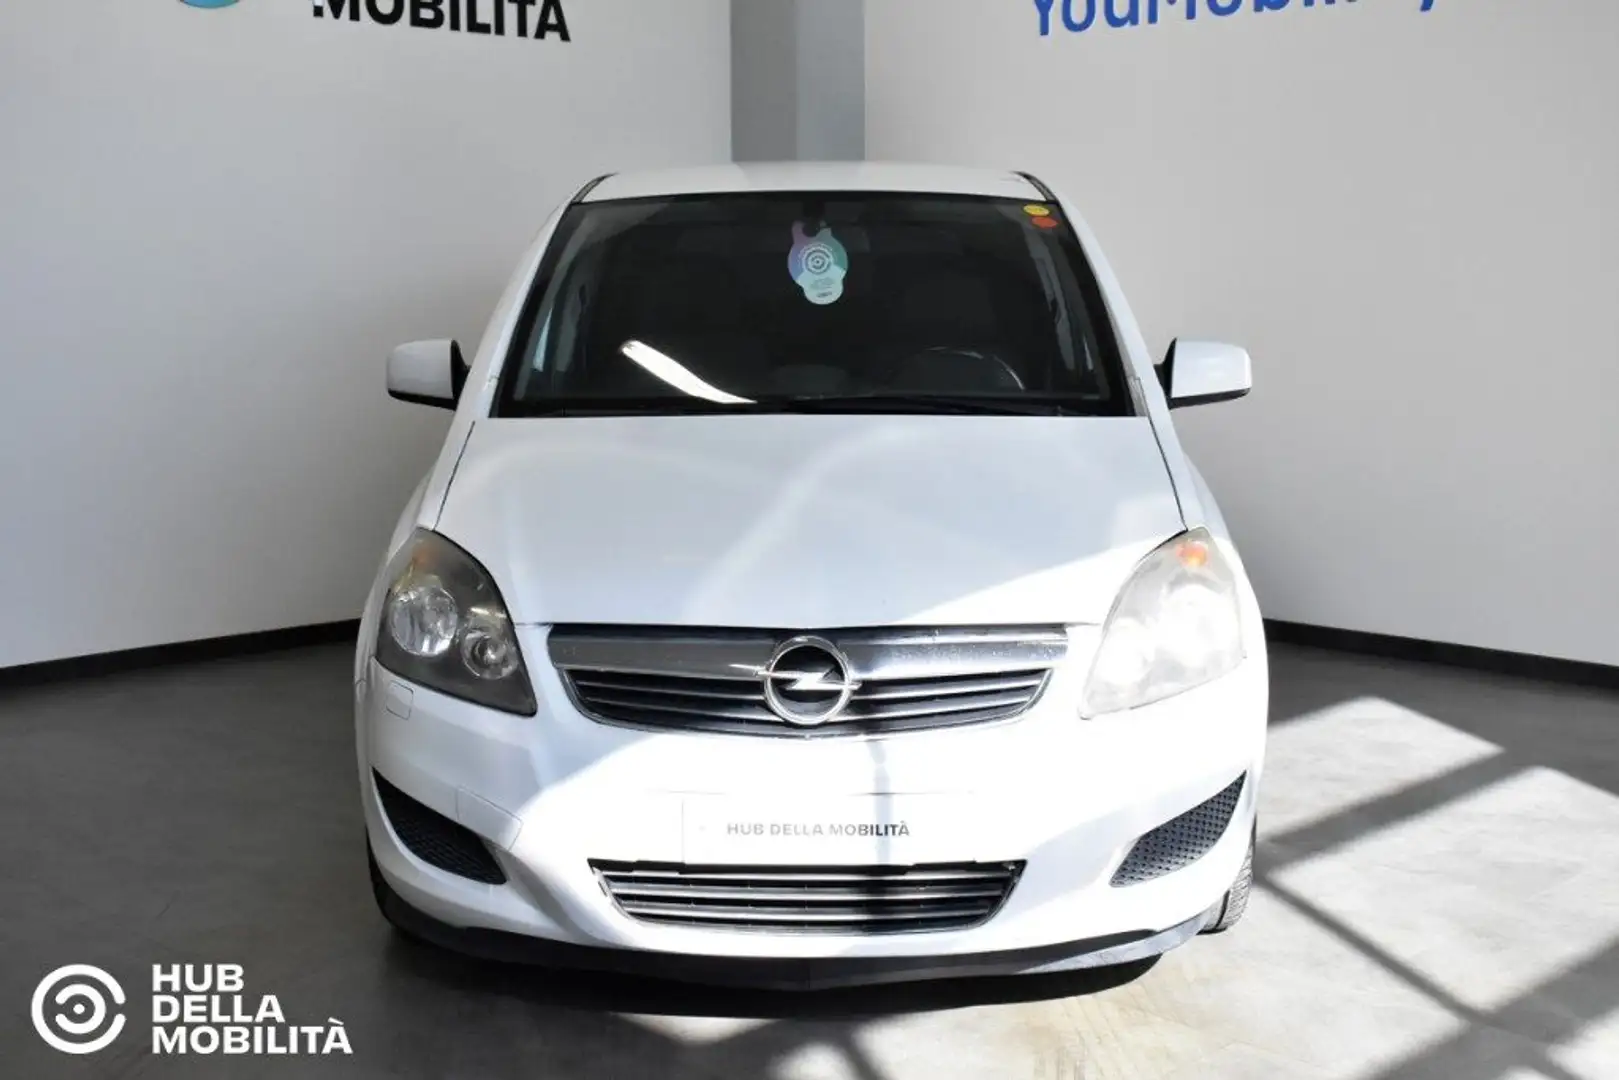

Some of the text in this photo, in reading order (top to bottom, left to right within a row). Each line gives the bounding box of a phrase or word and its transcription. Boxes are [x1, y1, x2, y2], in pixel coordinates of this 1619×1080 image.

[727, 820, 910, 836] HUB DELLA MOBILITÀ
